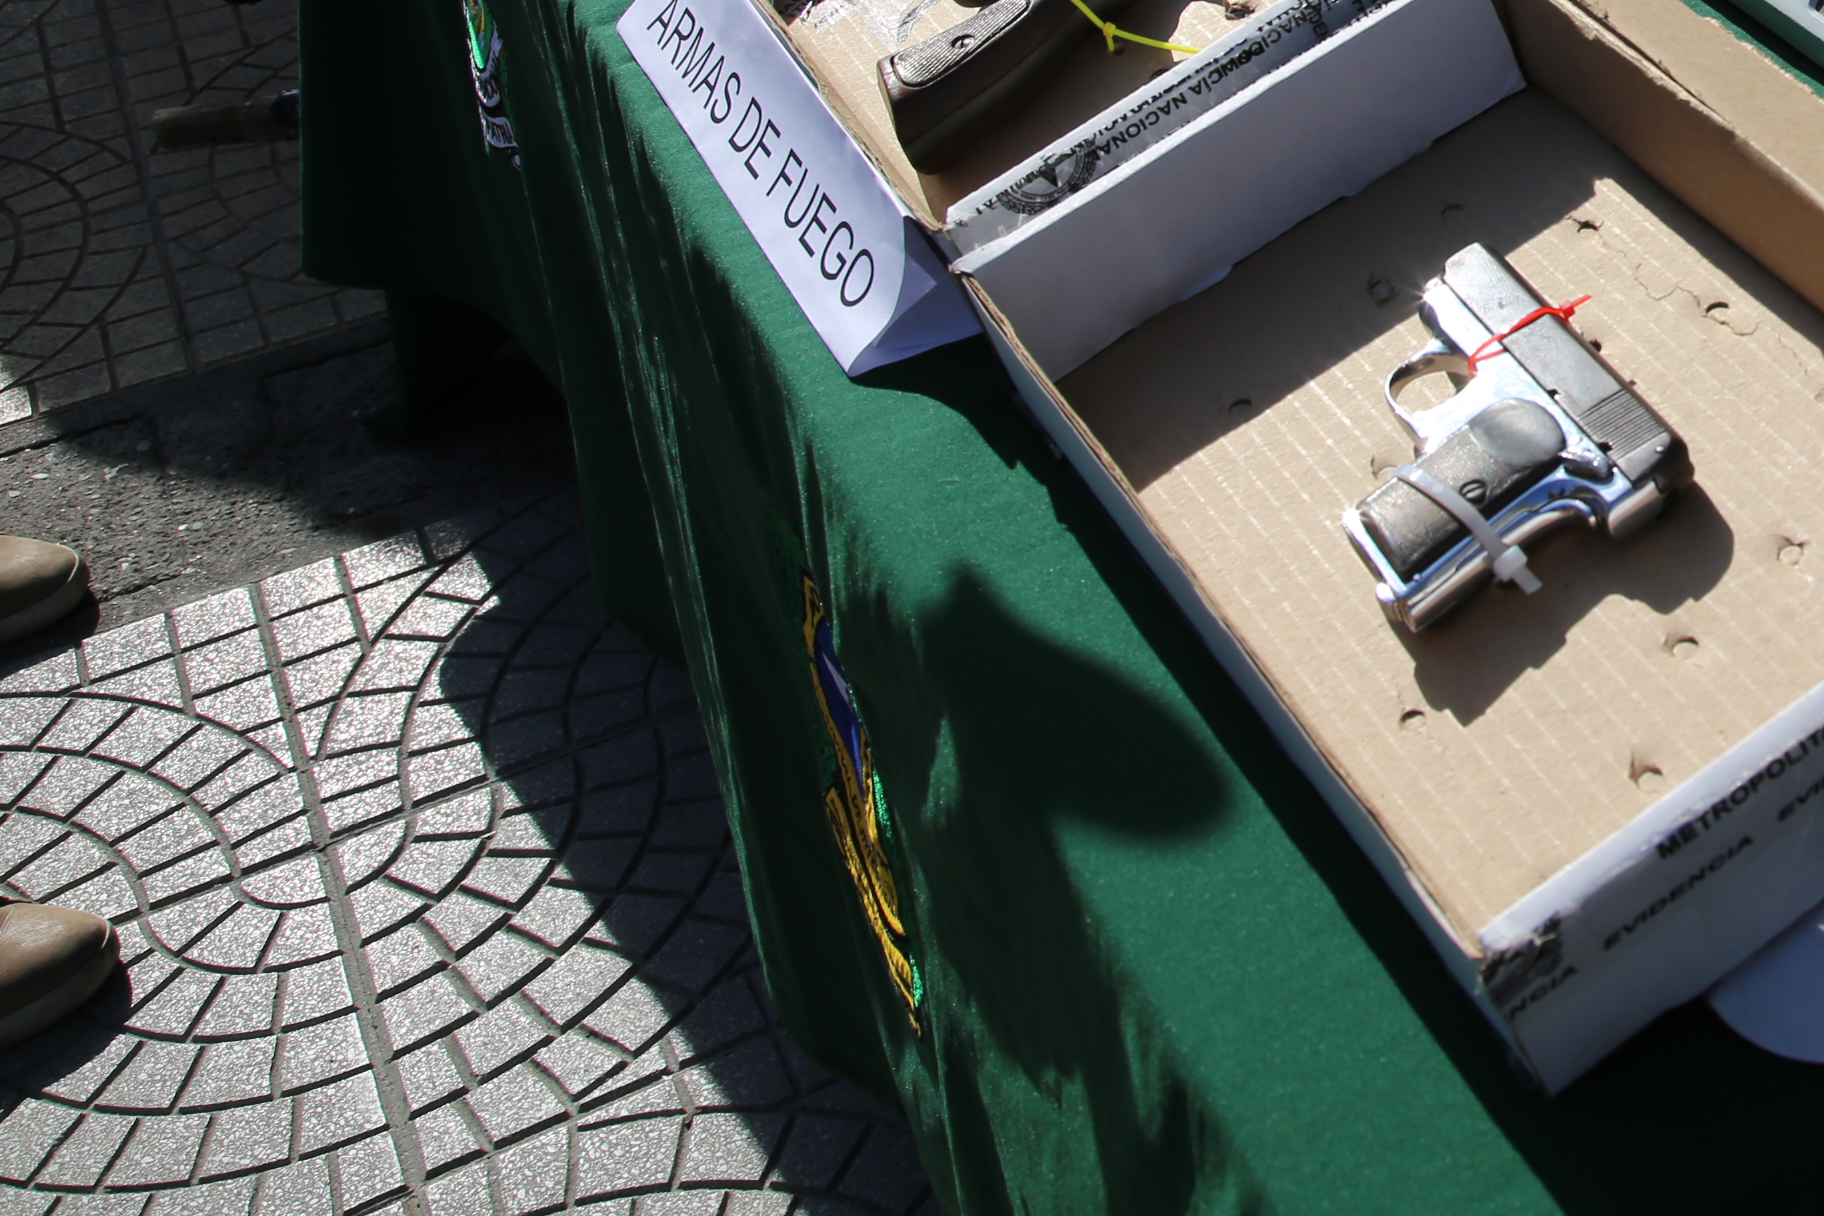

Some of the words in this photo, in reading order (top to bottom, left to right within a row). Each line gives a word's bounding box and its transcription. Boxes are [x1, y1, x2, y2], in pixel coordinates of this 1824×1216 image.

[727, 96, 781, 181] DE
[765, 147, 875, 309] FUEGO
[1603, 834, 1754, 952] EVIDENCIA
